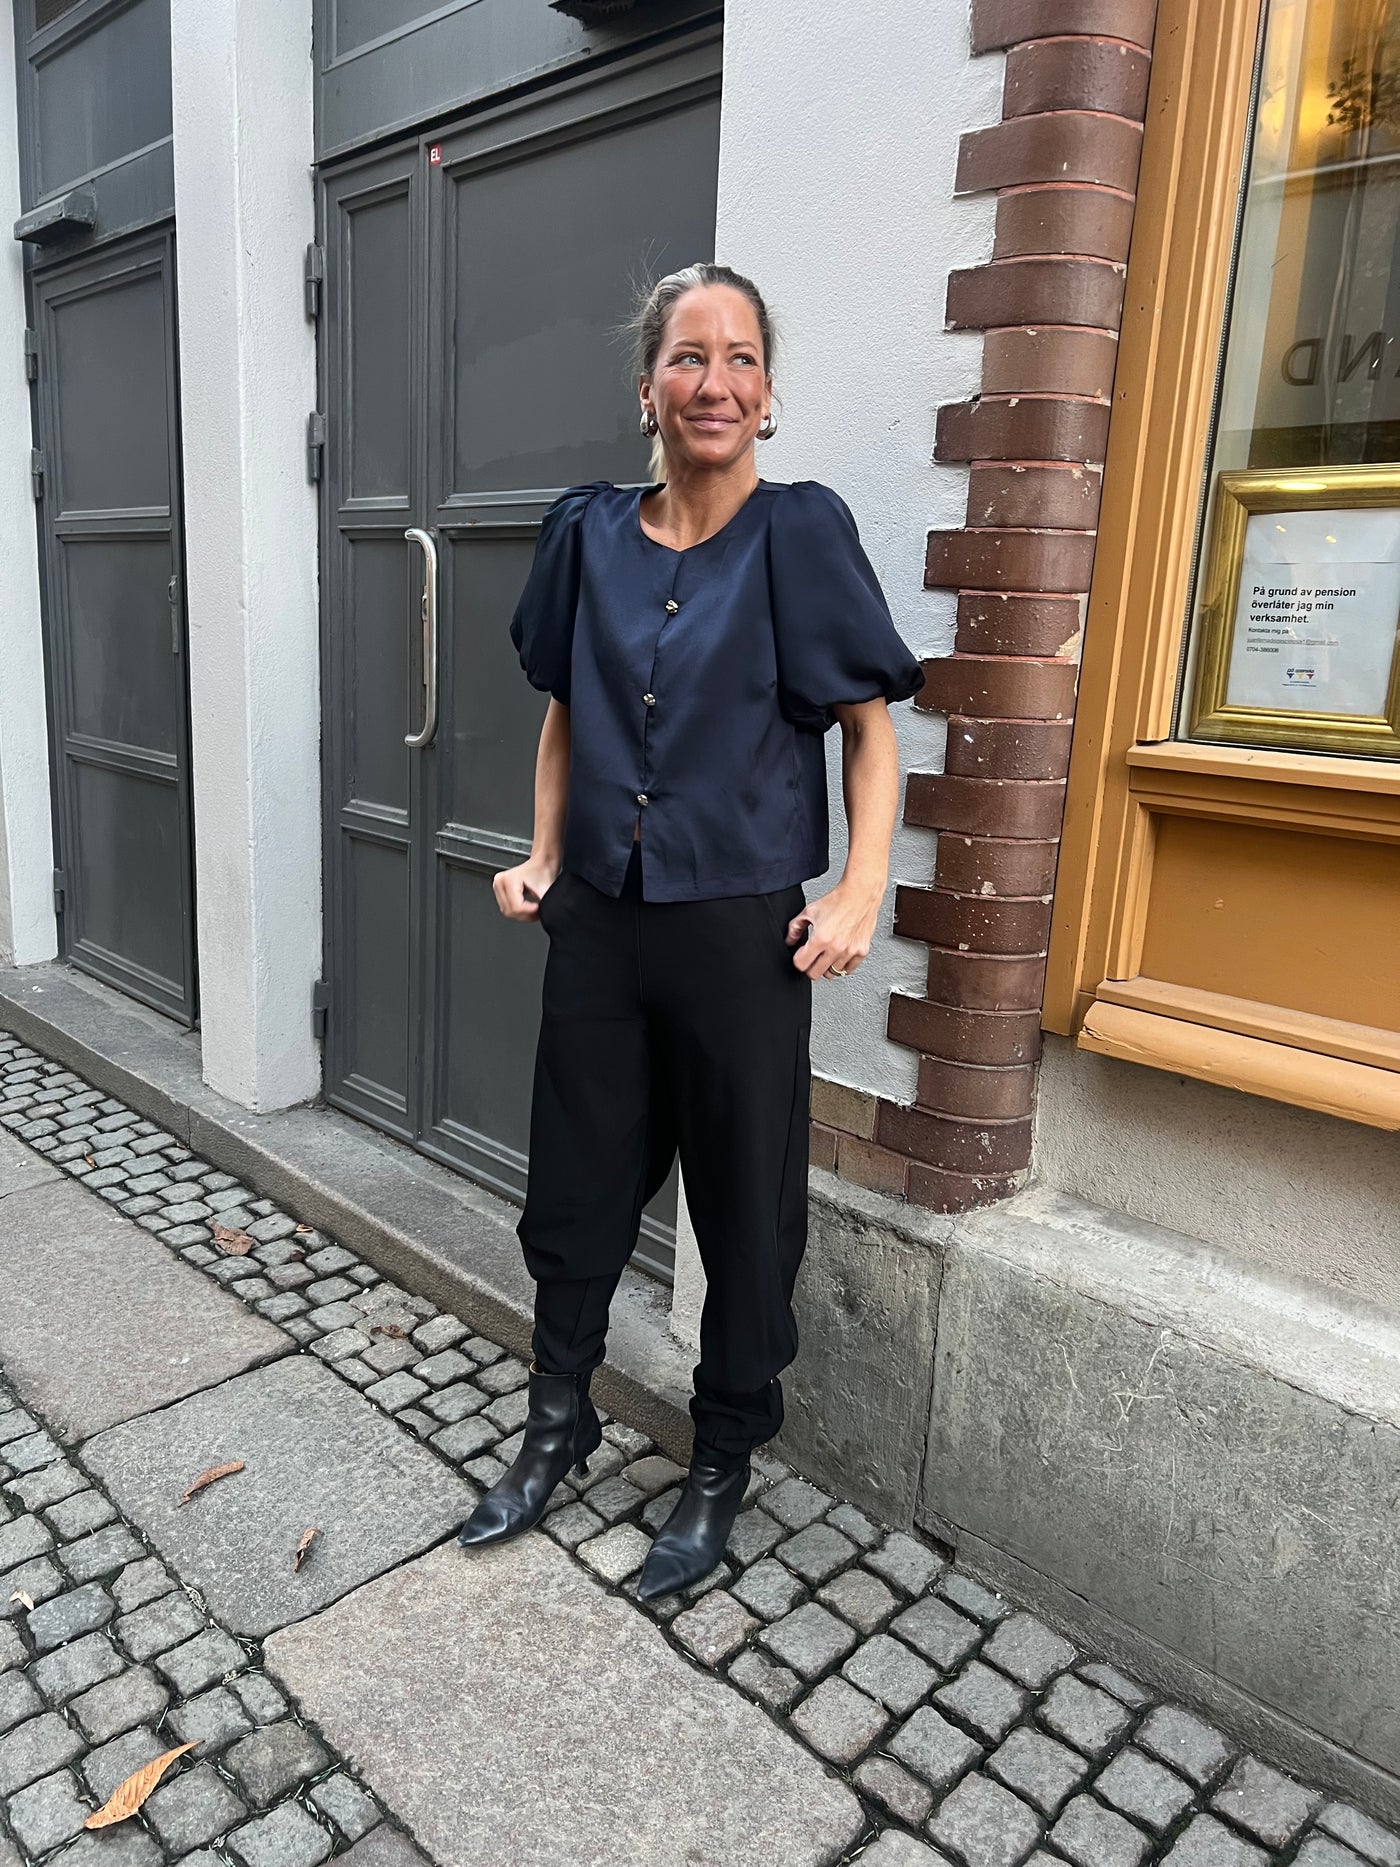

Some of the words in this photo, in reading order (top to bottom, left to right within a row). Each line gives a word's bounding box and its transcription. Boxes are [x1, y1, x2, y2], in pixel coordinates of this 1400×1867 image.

[430, 148, 441, 163] EL
[1252, 586, 1265, 596] På
[1267, 587, 1297, 598] grund
[1300, 588, 1312, 596] av
[1314, 588, 1356, 598] pension
[1251, 600, 1295, 609] överlåter
[1296, 601, 1312, 611] jag
[1315, 601, 1334, 610] min
[1249, 613, 1309, 623] verksamhet.
